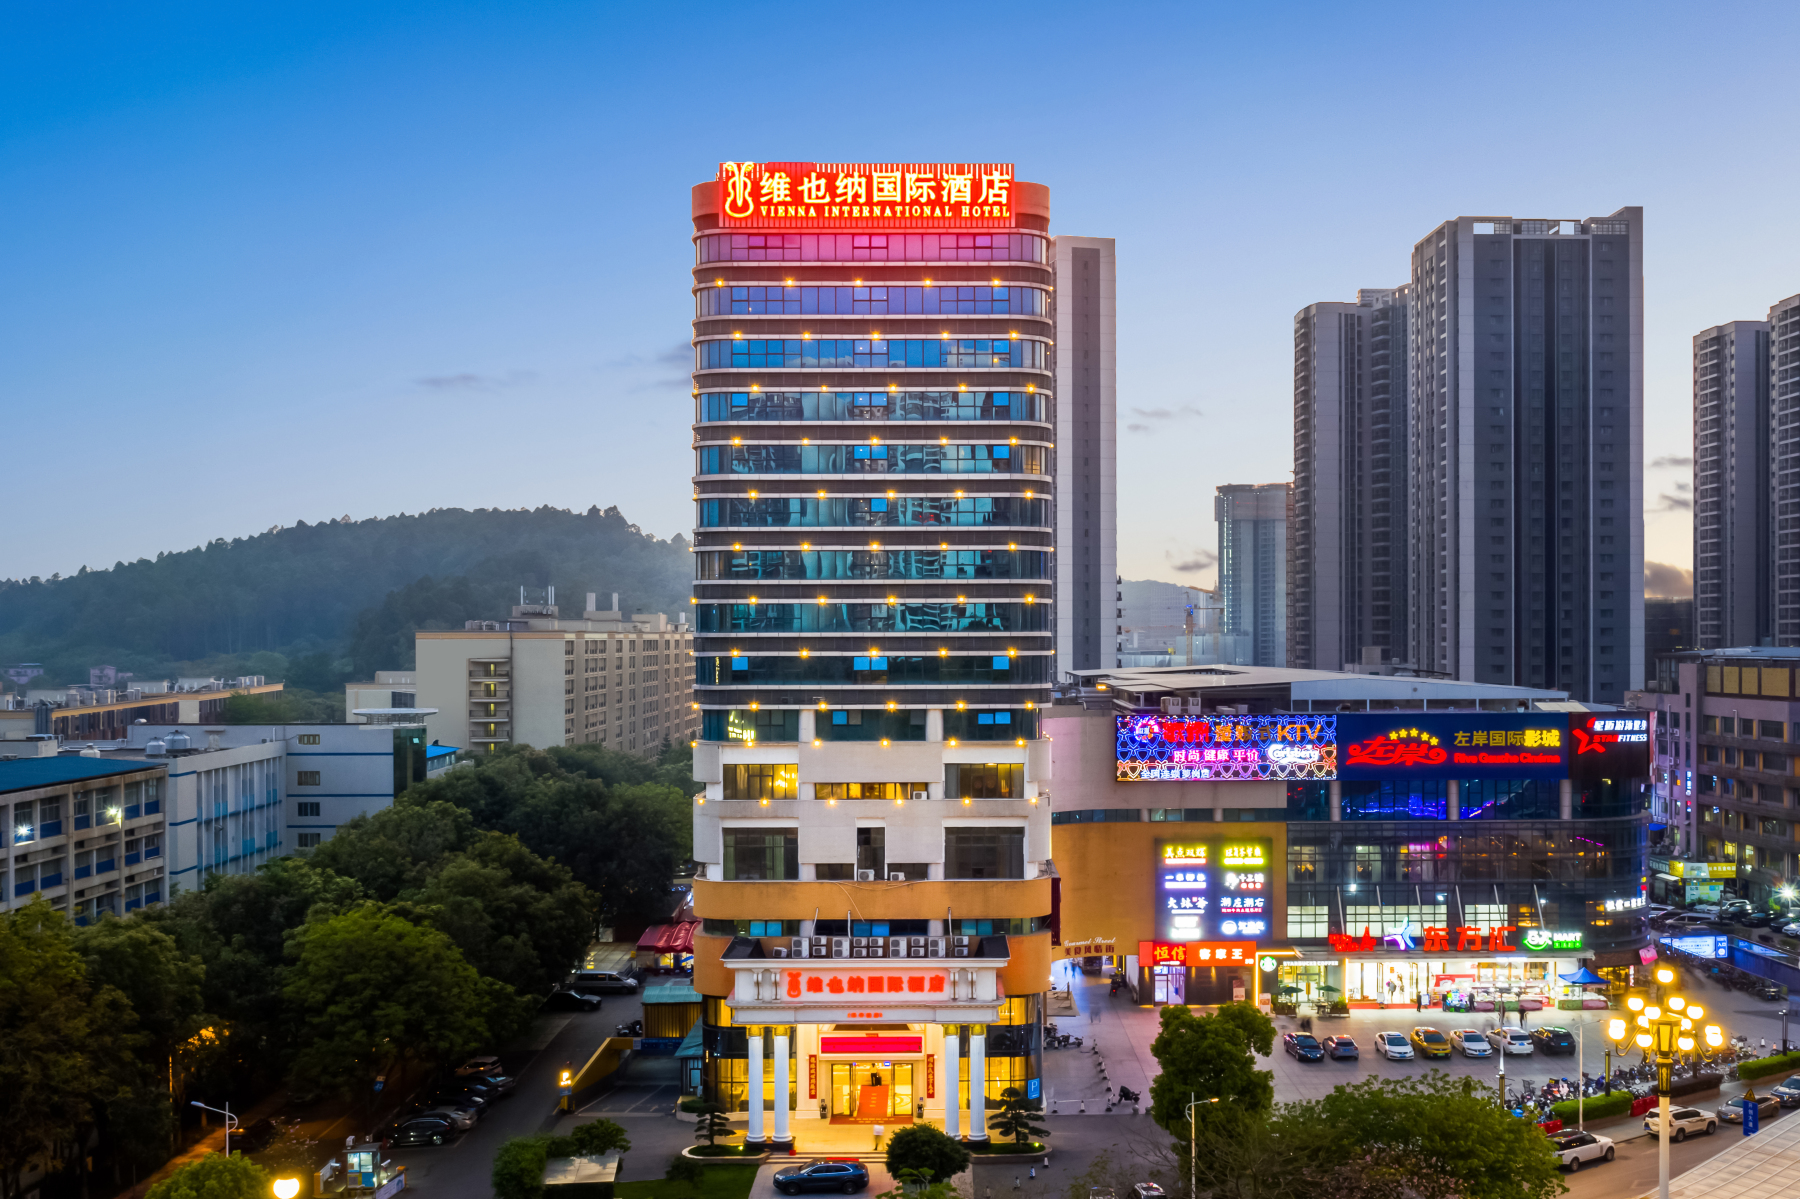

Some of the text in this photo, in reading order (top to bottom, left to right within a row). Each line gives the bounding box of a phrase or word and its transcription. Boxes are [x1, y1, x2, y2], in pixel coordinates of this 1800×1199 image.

[759, 171, 1011, 204] 维也纳国际酒店
[760, 205, 1011, 218] VIENNA INTERNATIONAL HOTEL
[1454, 729, 1560, 748] 左岸国际影城
[1173, 749, 1259, 761] 时尚 健康 平价
[1268, 744, 1320, 762] Carlsberg
[1423, 926, 1517, 952] 东方汇
[1553, 933, 1582, 942] MART
[1154, 946, 1186, 960] 恒信
[1031, 1080, 1038, 1090] P
